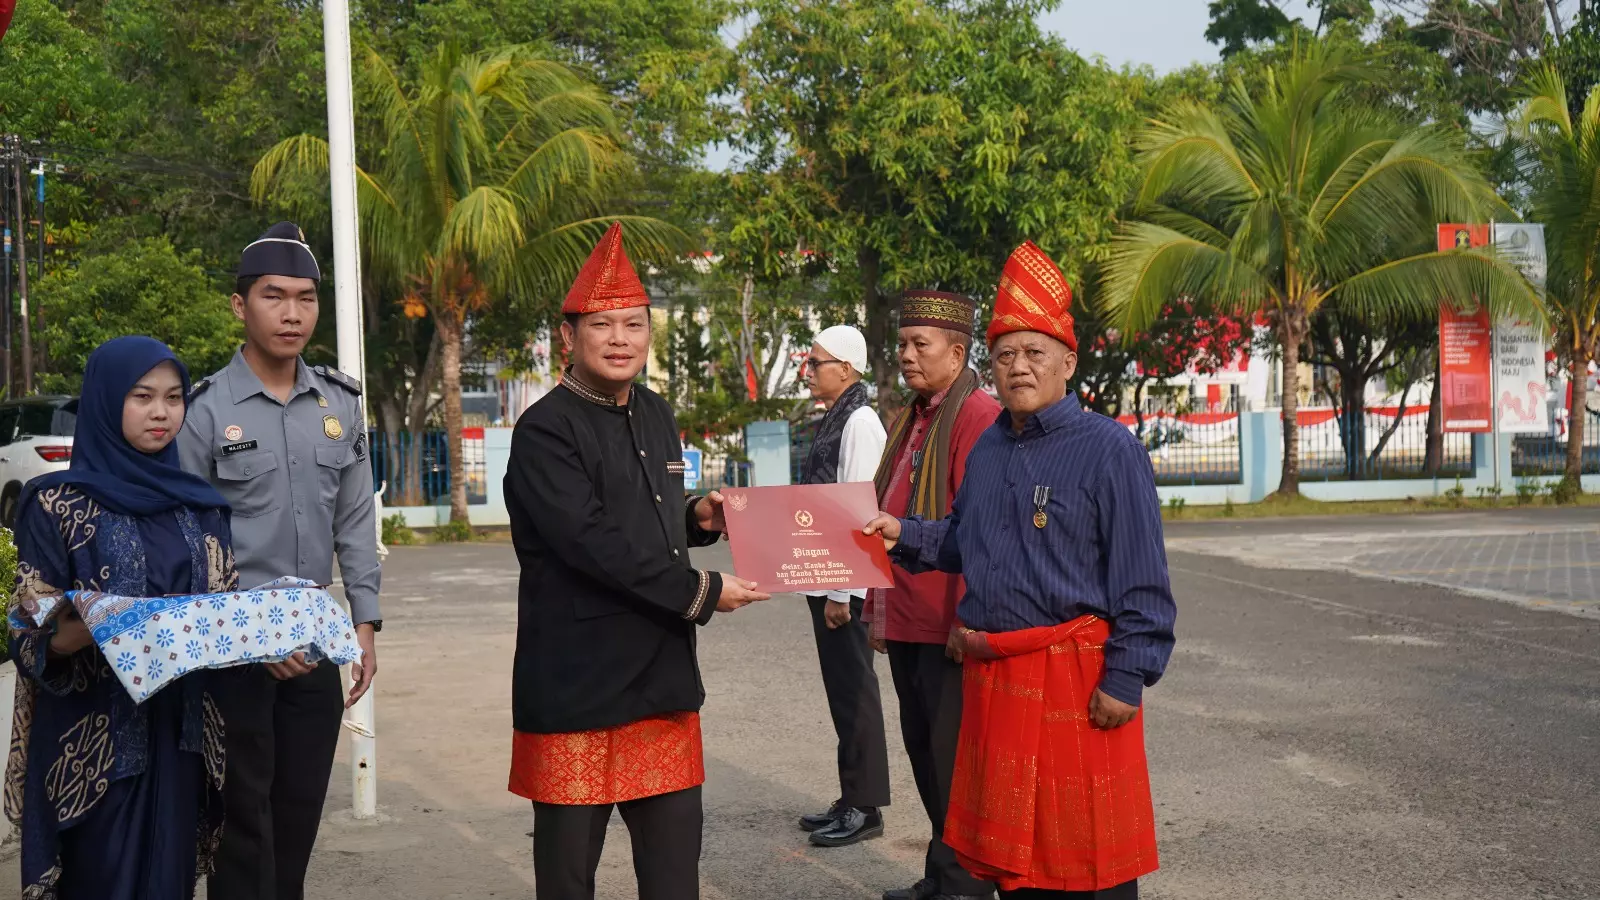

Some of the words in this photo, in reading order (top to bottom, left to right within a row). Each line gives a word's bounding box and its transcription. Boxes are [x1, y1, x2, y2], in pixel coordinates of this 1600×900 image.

[1501, 356, 1536, 368] INDONESIA
[1501, 367, 1520, 376] MAJU
[228, 443, 252, 451] MAJESTY
[792, 547, 830, 559] Piagam
[781, 563, 803, 571] Gelar,
[804, 562, 826, 570] Tanda
[826, 560, 846, 569] Jasa,
[790, 570, 812, 578] Tanda
[813, 568, 853, 577] Kehormatan
[815, 576, 850, 584] Indonesia
